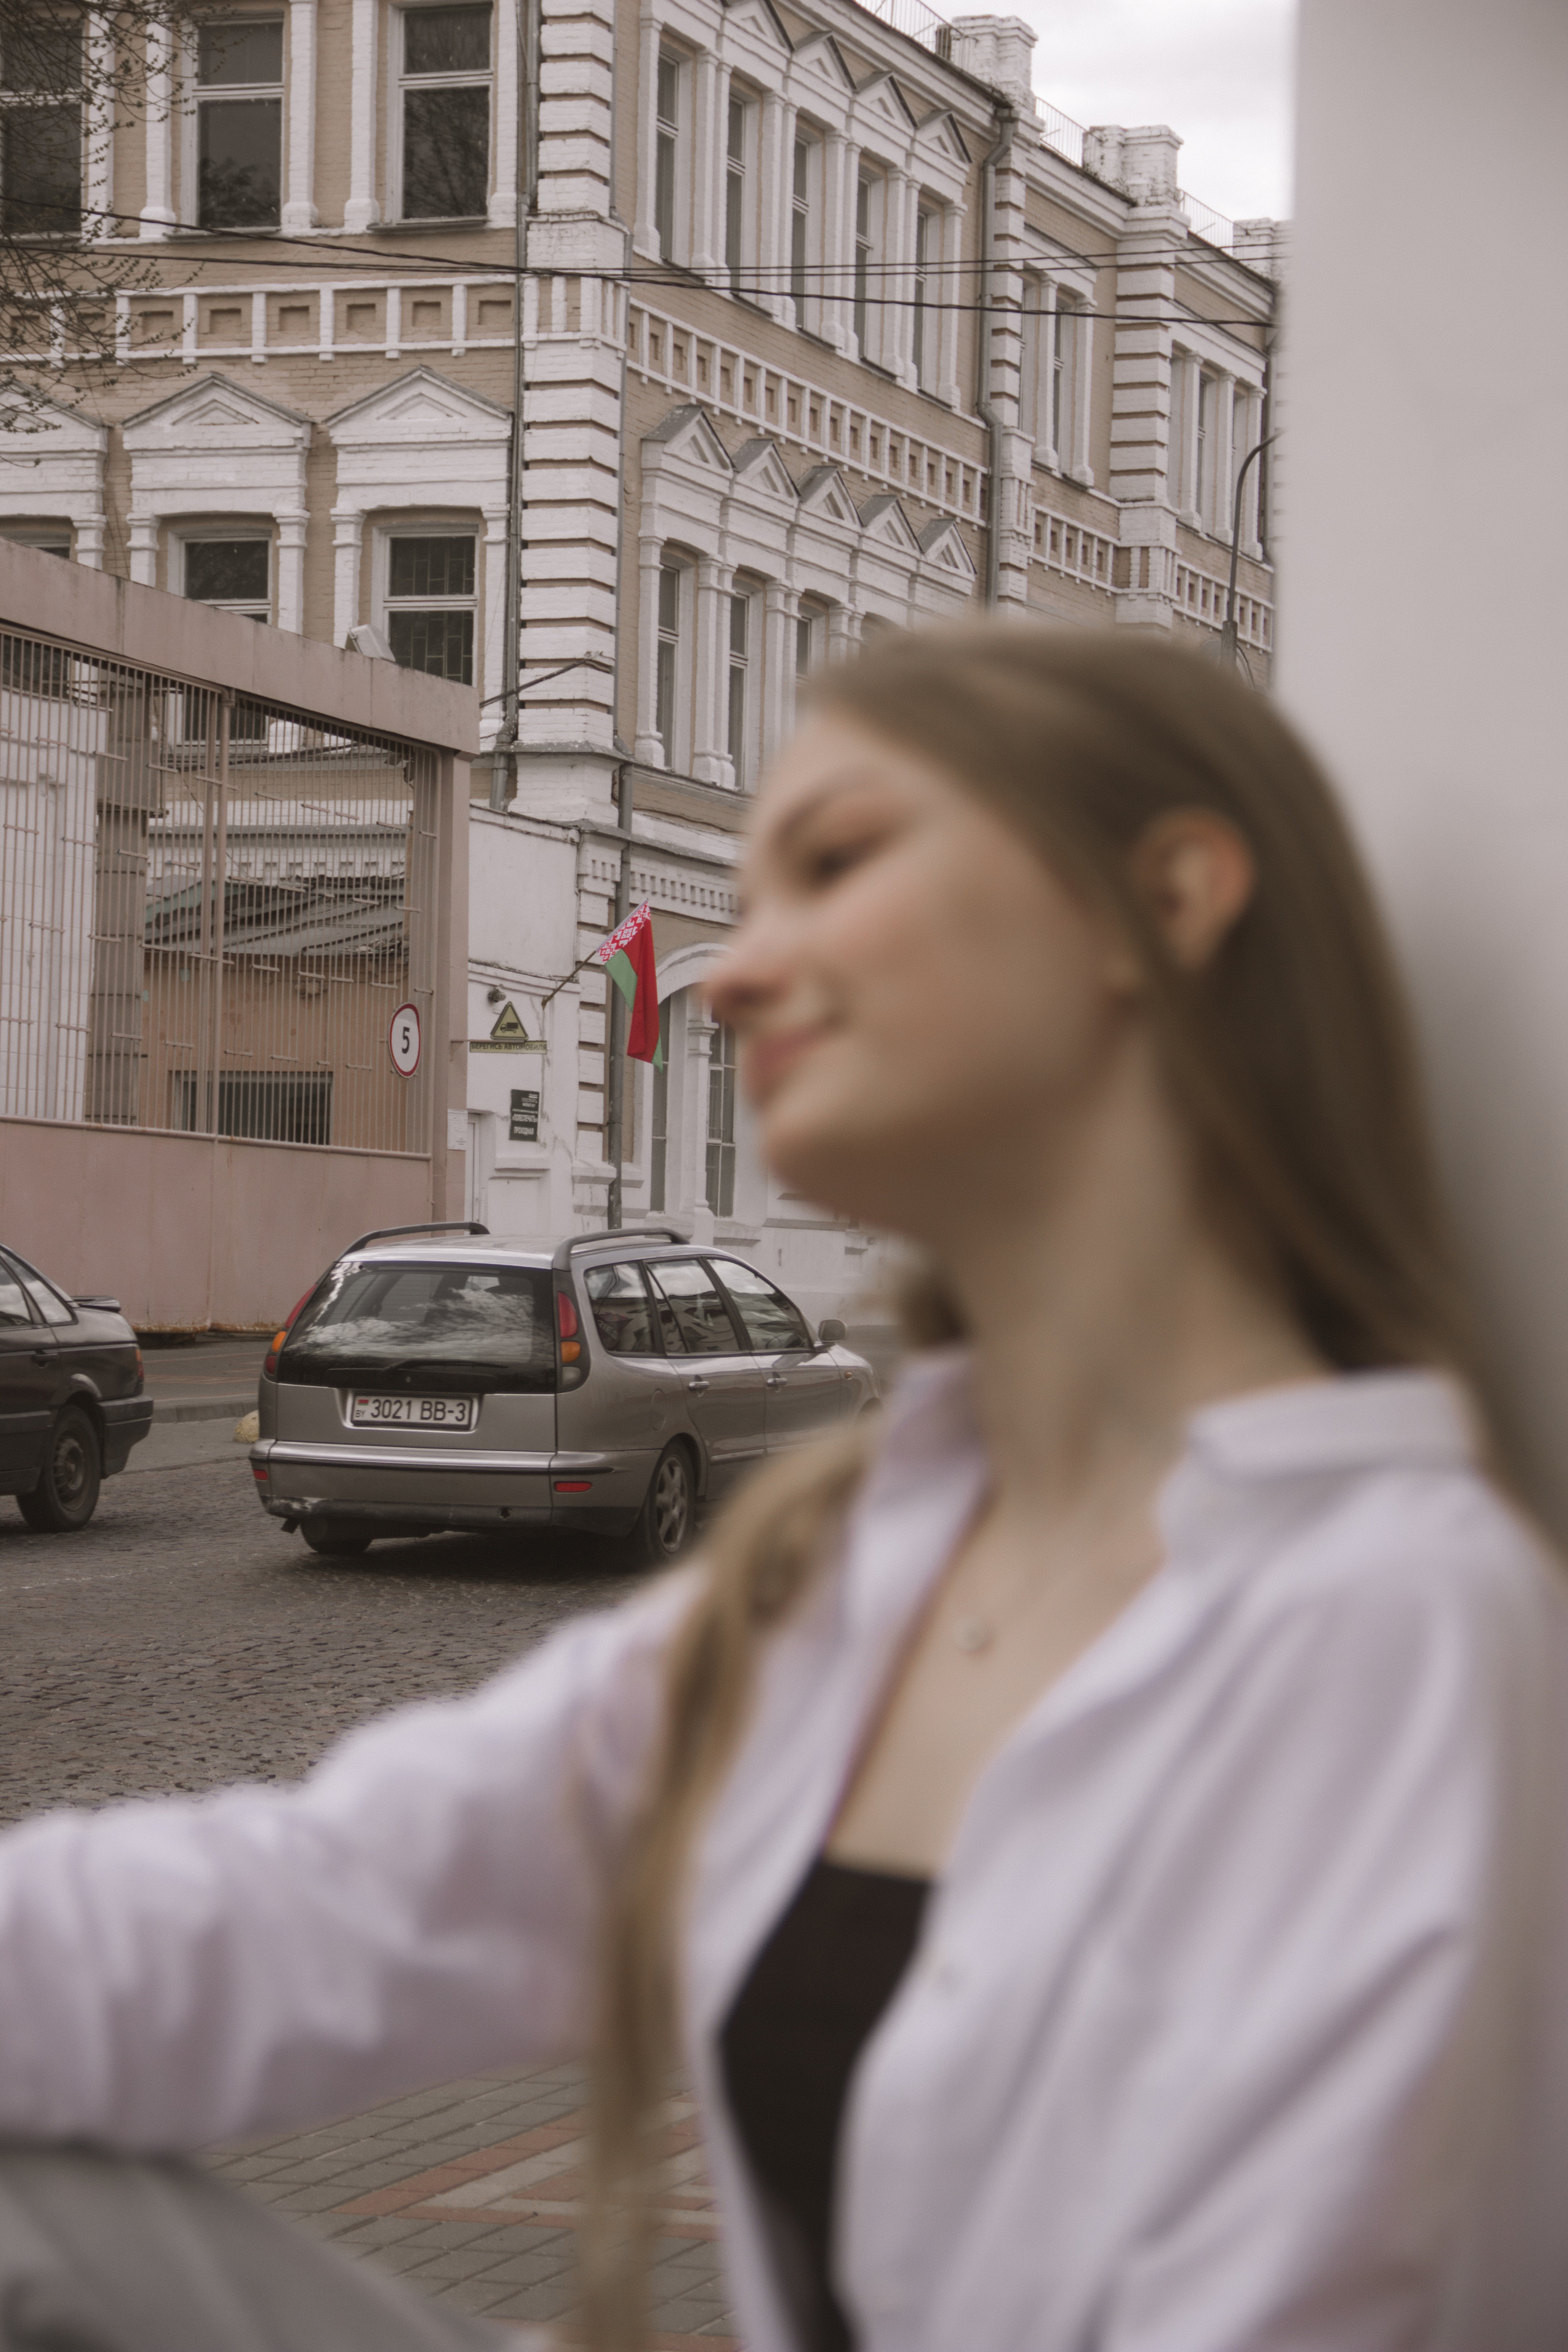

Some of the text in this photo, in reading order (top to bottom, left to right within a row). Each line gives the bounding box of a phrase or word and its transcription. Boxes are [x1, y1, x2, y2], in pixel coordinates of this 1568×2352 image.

[401, 1026, 410, 1054] 5
[504, 1042, 546, 1051] АВТОМОБИЛЯ
[355, 1409, 366, 1418] BY
[371, 1398, 466, 1422] 3021 BB-3
